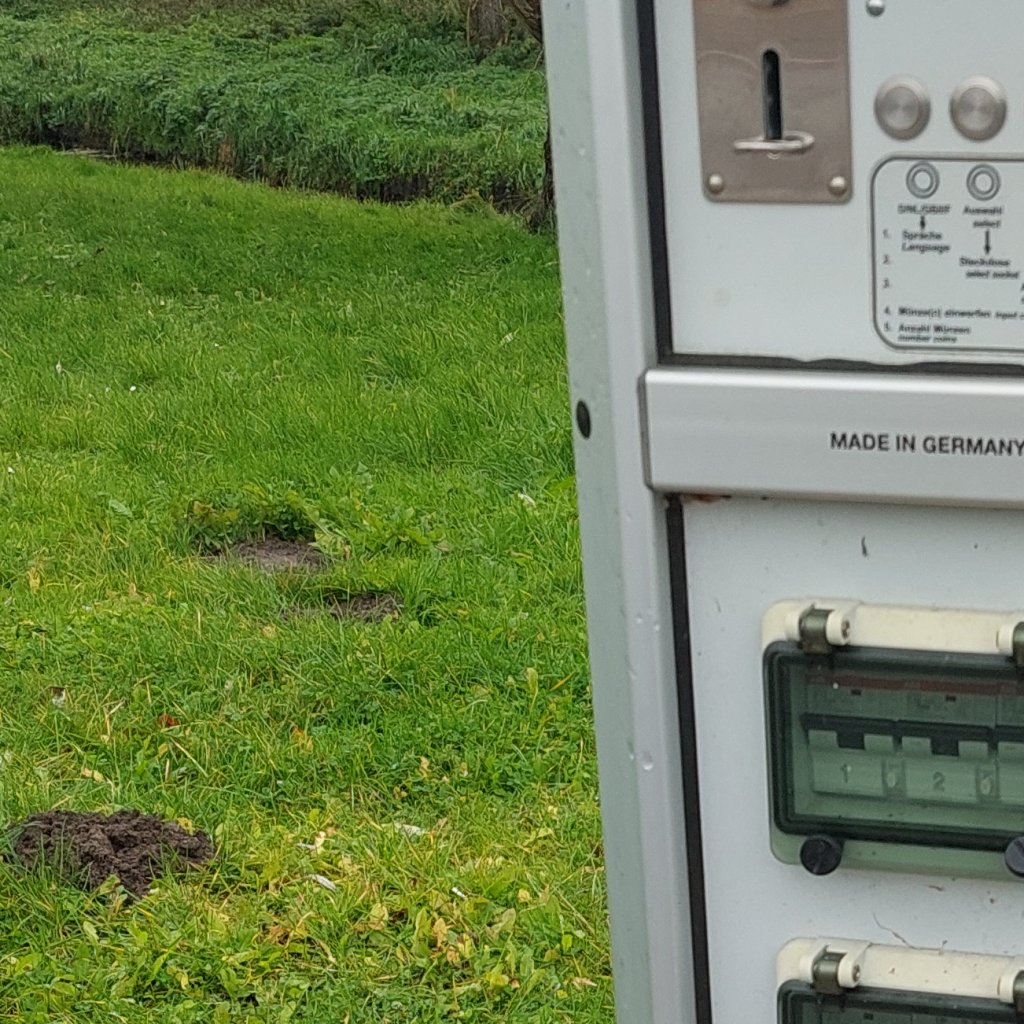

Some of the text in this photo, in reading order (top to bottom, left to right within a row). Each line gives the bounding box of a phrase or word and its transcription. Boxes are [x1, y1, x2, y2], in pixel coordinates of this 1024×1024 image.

[901, 242, 950, 254] Language
[830, 432, 889, 452] MADE
[895, 434, 915, 453] IN
[841, 764, 853, 783] 1
[932, 771, 945, 791] 2
